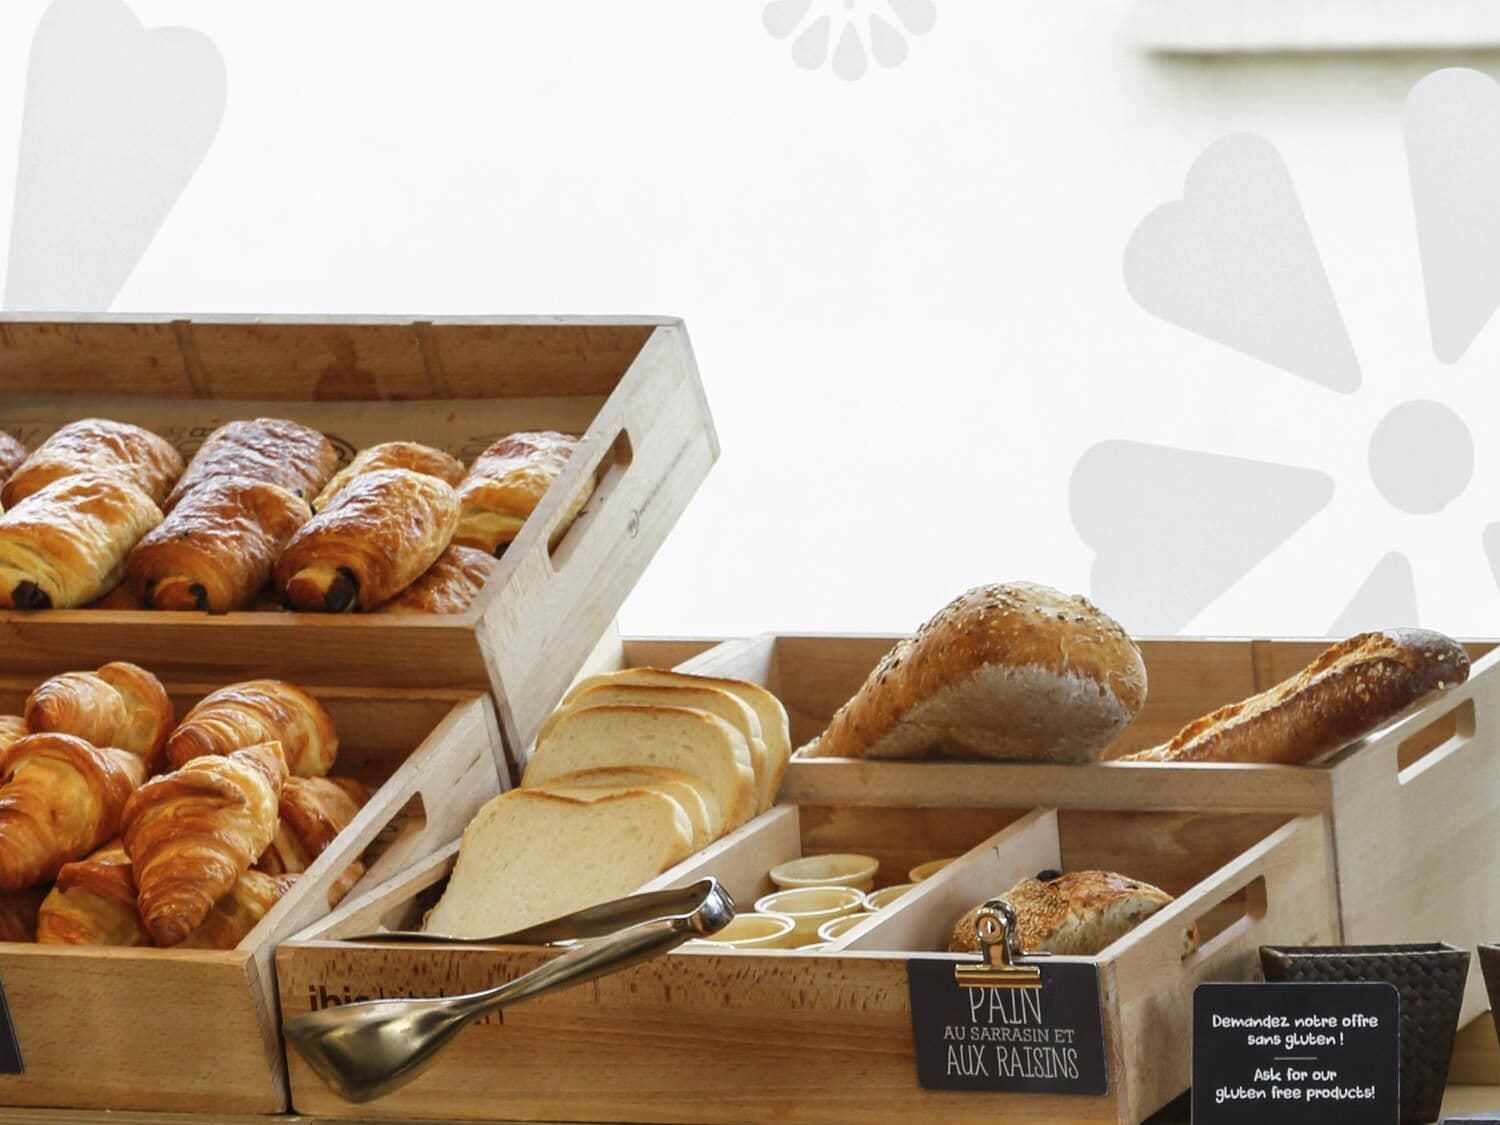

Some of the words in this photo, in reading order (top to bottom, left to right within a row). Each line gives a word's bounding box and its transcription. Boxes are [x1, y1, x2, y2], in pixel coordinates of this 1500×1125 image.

[969, 987, 1042, 1025] PAIN
[1212, 1014, 1290, 1028] Demandez
[1294, 1014, 1337, 1028] notre
[1342, 1014, 1379, 1028] offre
[944, 1026, 965, 1041] AU
[970, 1027, 1049, 1043] SARRASIN
[1054, 1029, 1074, 1044] ET
[1247, 1034, 1281, 1046] sans
[1285, 1032, 1336, 1050] gluten
[947, 1044, 989, 1077] AUX
[997, 1046, 1079, 1079] RAISINS
[1253, 1067, 1282, 1082] Ask
[1286, 1068, 1308, 1081] for
[1312, 1071, 1337, 1081] our
[1215, 1086, 1266, 1103] gluten
[1271, 1085, 1302, 1099] free
[1306, 1085, 1376, 1102] products!
